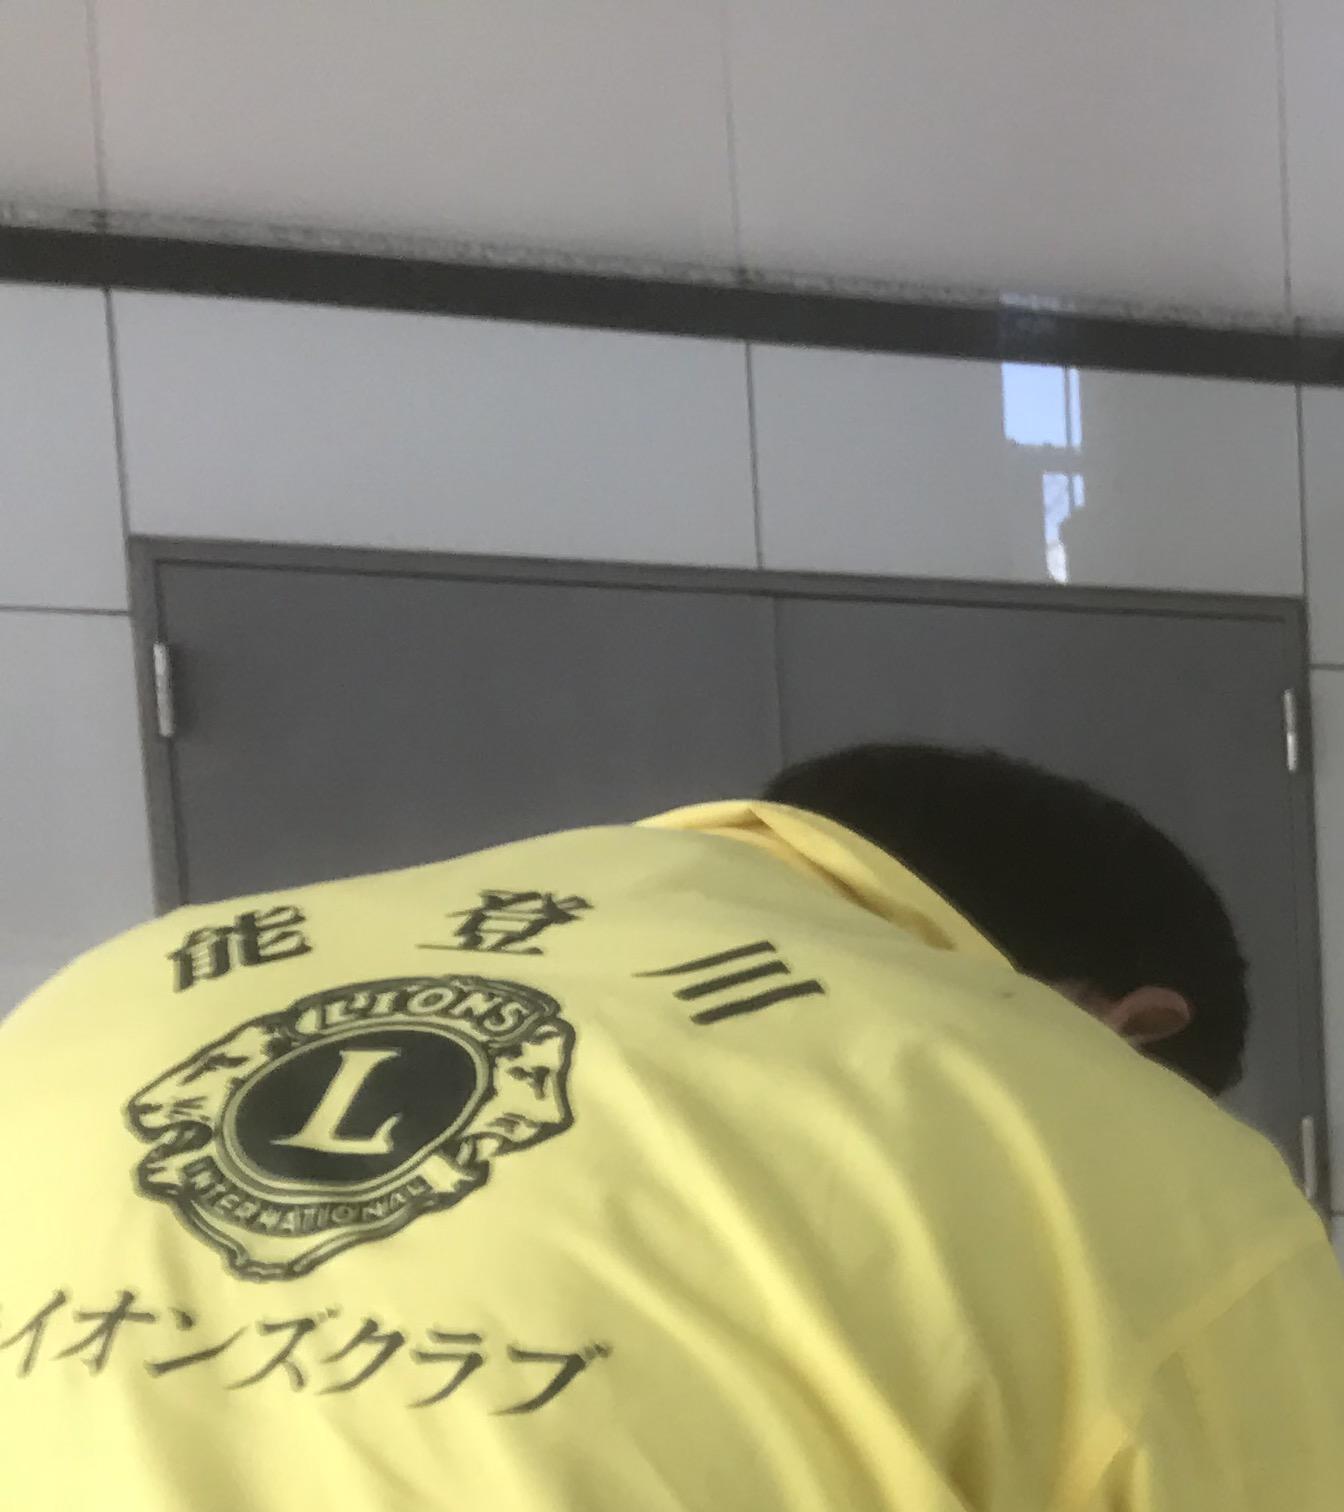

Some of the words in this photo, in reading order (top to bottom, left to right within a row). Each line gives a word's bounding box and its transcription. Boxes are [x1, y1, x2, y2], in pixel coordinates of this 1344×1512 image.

[167, 889, 828, 1025] 能登川
[270, 1048, 401, 1154] L
[0, 1289, 612, 1415] イオンズクラブ
